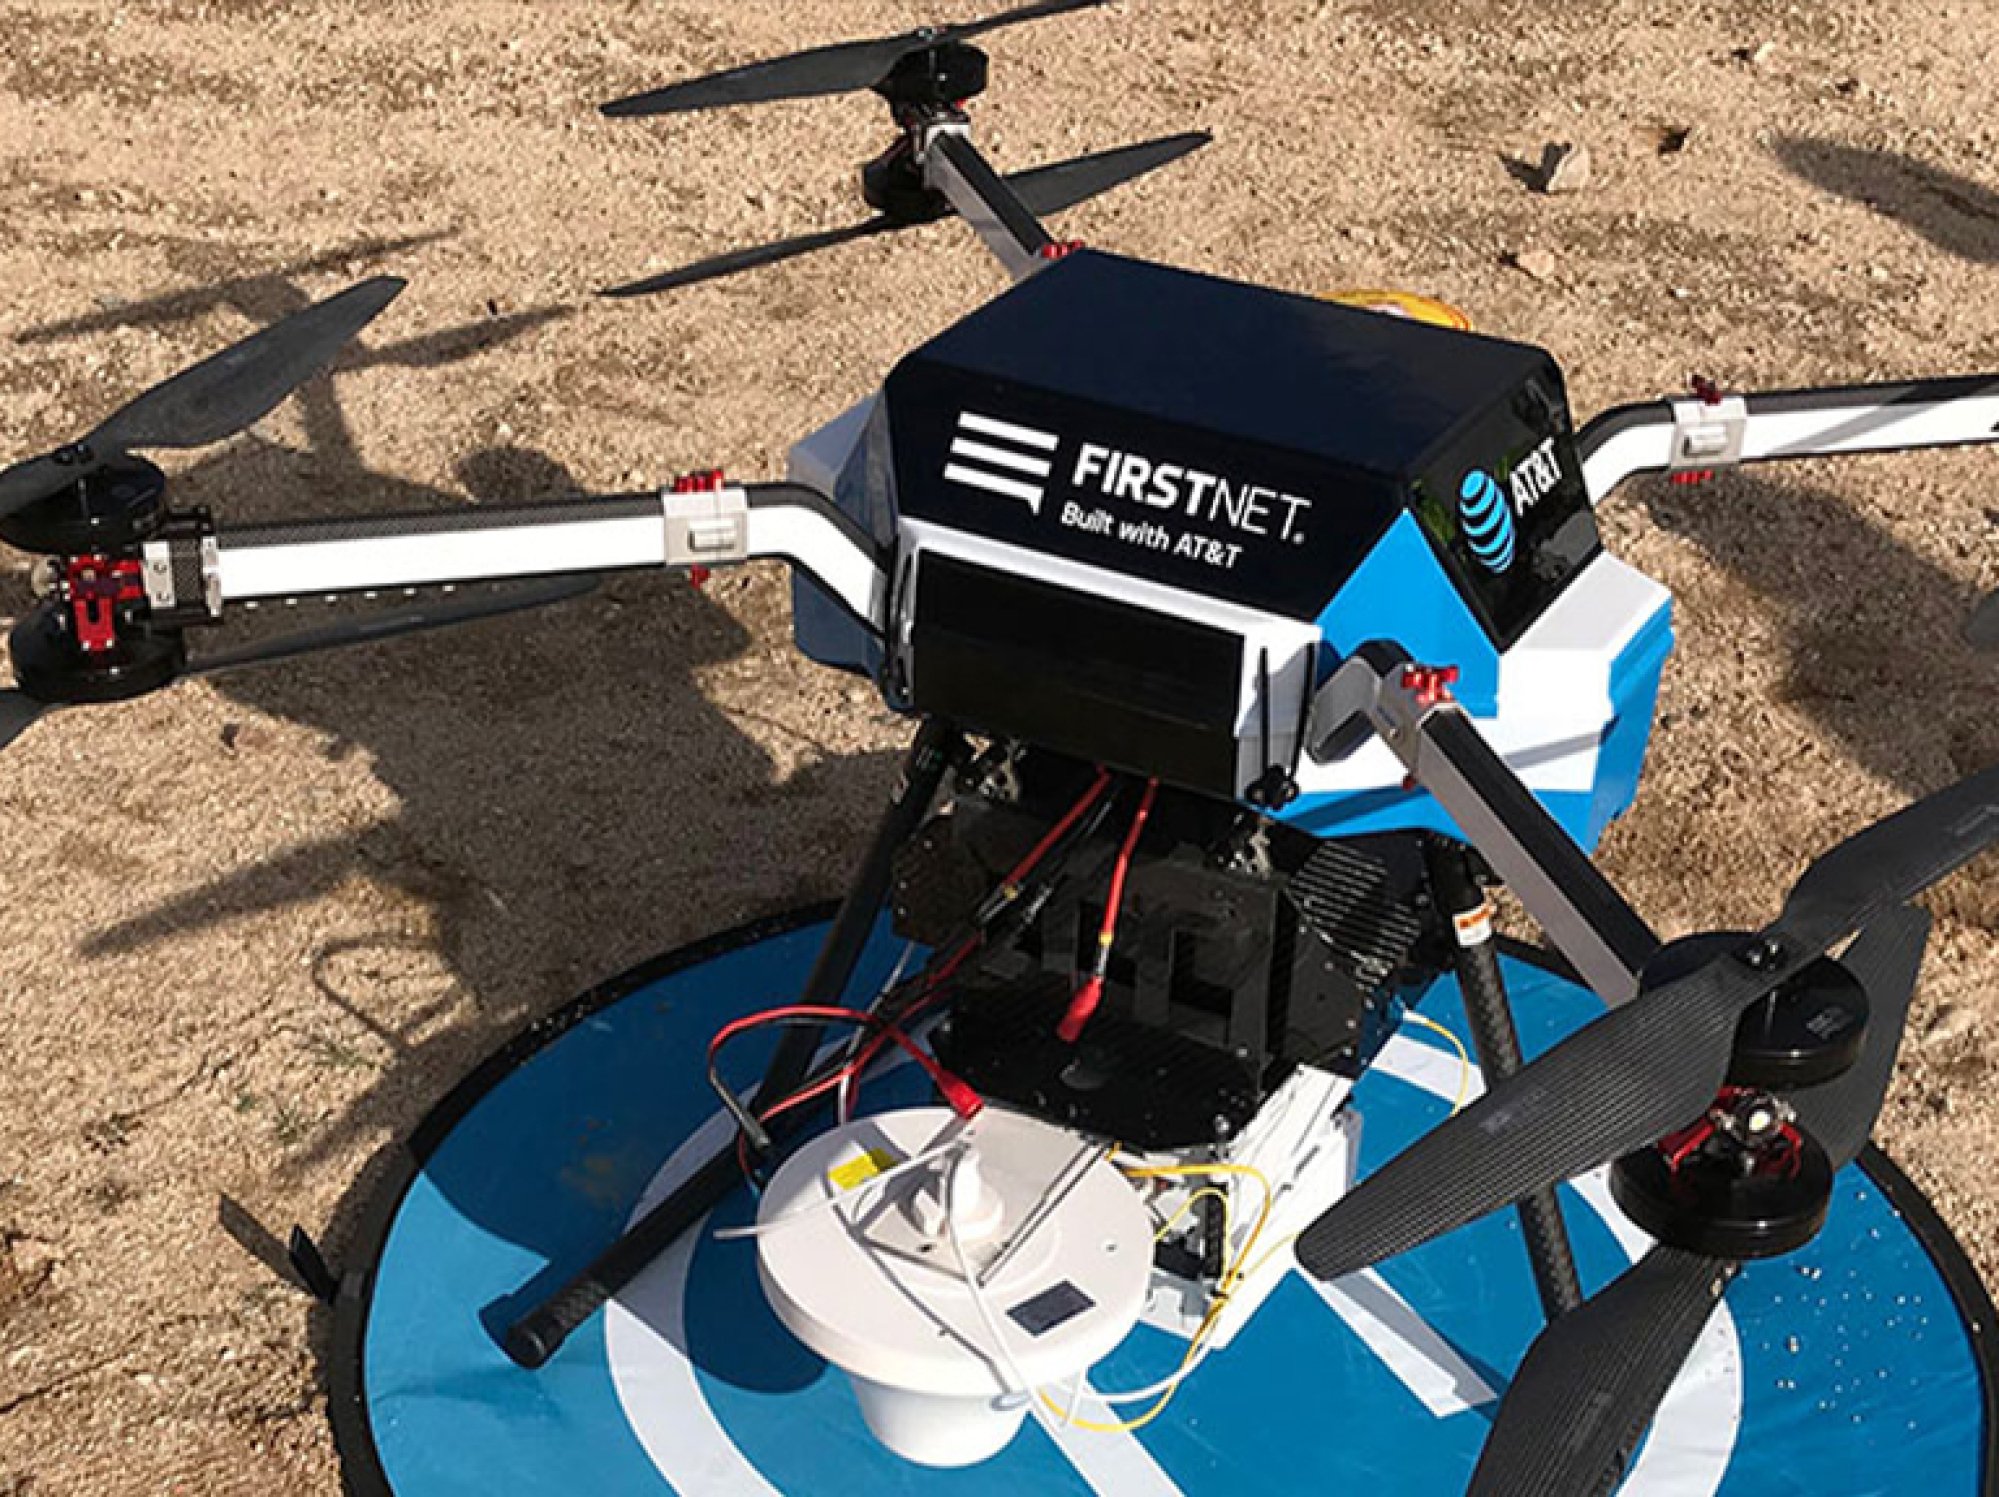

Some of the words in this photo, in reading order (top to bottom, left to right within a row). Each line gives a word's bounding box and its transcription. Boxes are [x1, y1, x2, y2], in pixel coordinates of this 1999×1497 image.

[1509, 436, 1562, 517] AT&T
[1061, 500, 1114, 535] Built
[1118, 520, 1170, 551] with
[1173, 531, 1243, 568] AT&T
